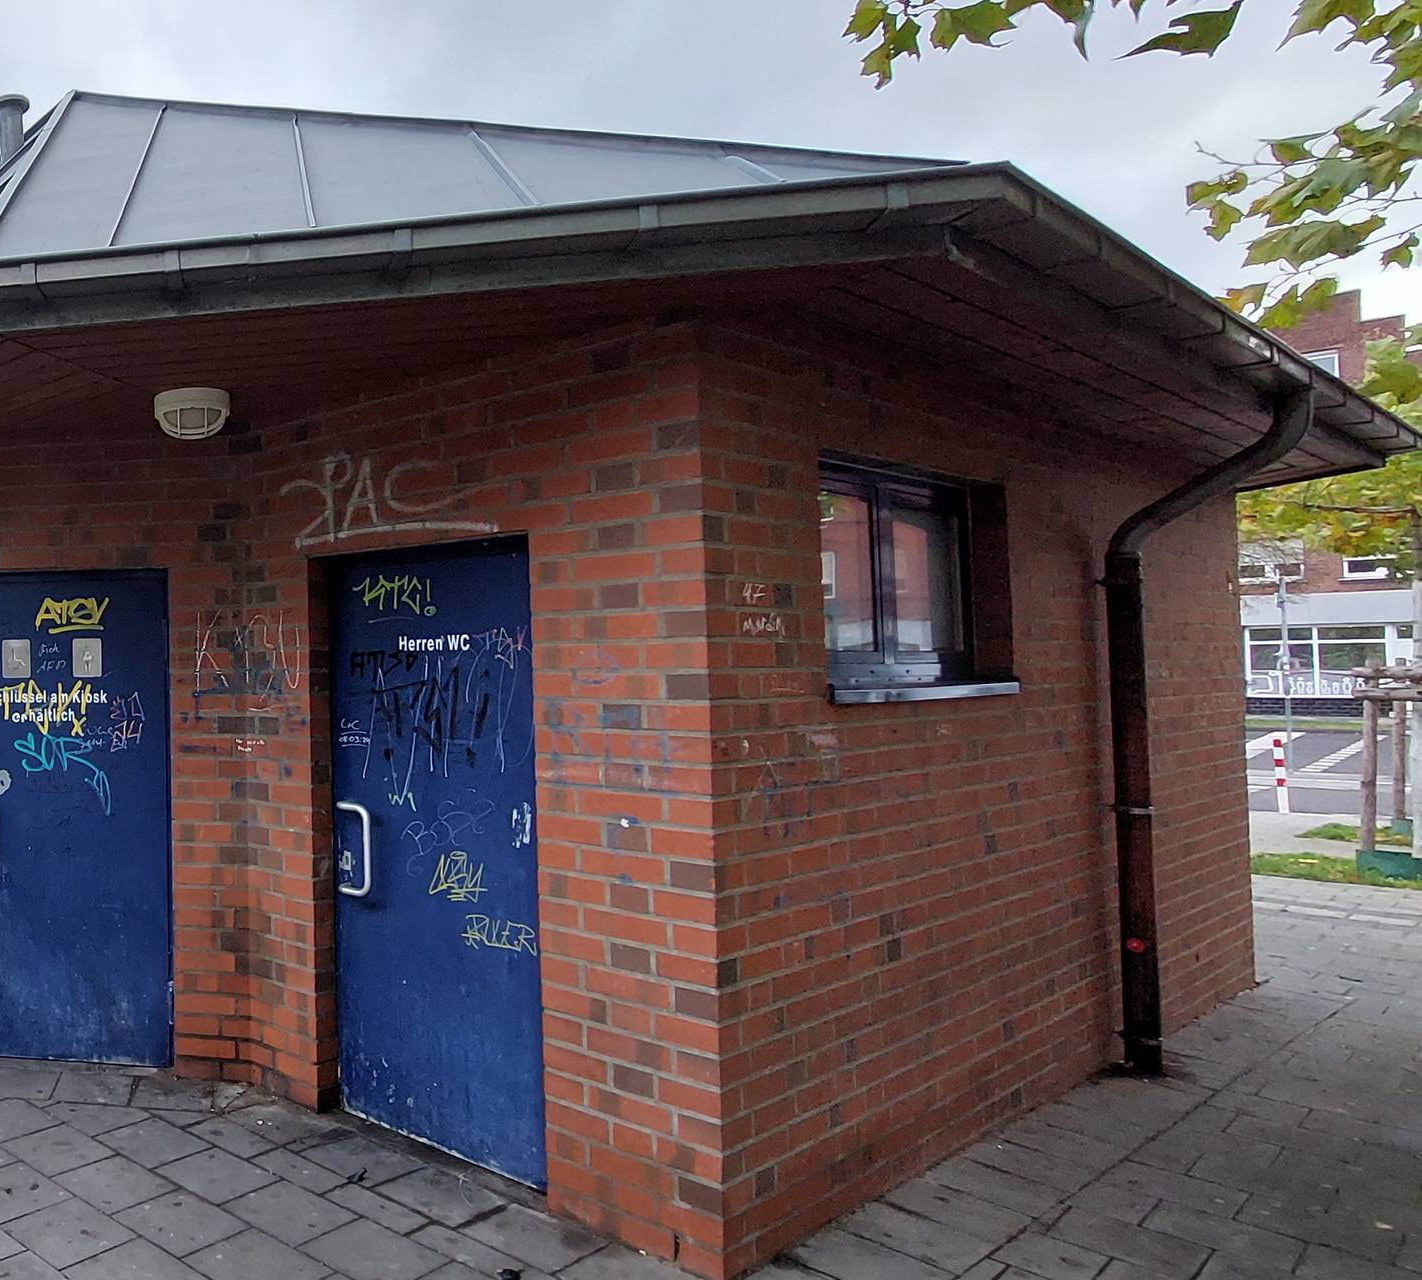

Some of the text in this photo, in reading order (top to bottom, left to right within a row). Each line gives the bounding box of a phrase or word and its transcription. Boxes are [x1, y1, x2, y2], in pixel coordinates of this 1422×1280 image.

[280, 452, 499, 550] 2PAC
[398, 633, 471, 652] Herren WC
[50, 692, 69, 703] am
[72, 689, 108, 704] Kiosk
